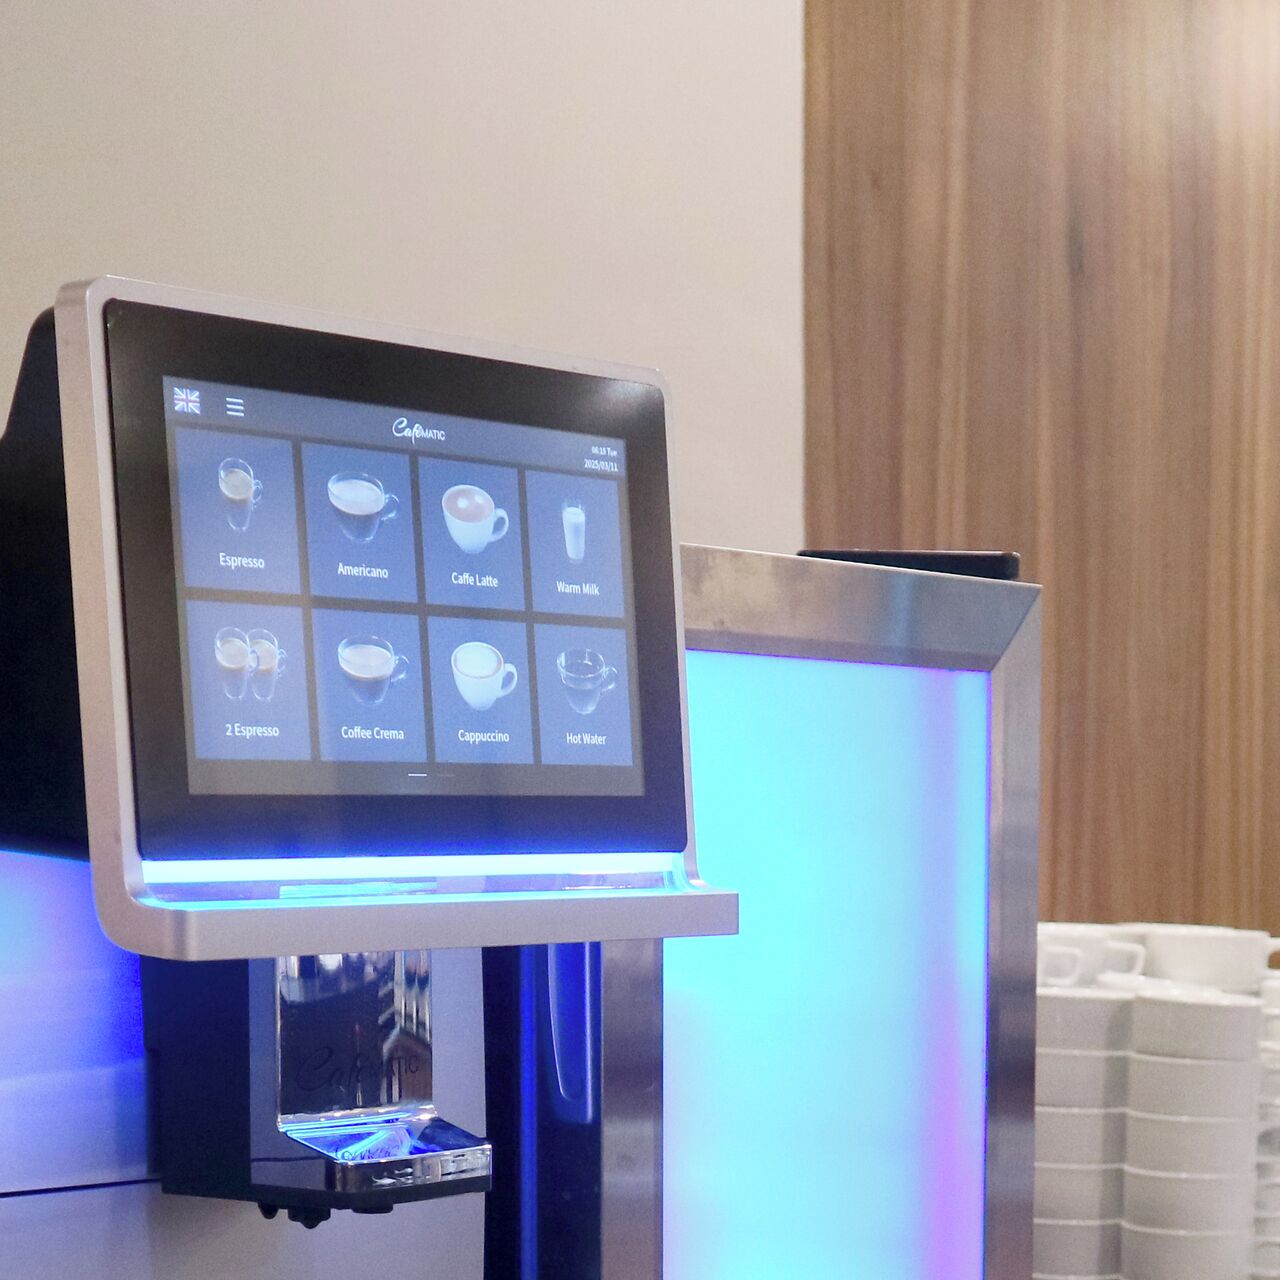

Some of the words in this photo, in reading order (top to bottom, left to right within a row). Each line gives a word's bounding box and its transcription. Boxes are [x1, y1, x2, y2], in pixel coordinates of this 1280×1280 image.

[584, 458, 619, 472] 2025/03/11
[219, 552, 265, 570] Espresso
[337, 562, 389, 579] Americano
[451, 571, 474, 585] Caffe
[475, 573, 499, 588] Latte
[556, 581, 581, 594] Warm
[582, 583, 600, 596] Milk
[225, 723, 233, 736] 2
[234, 723, 280, 739] Espresso
[341, 726, 372, 739] Coffee
[373, 727, 405, 740] Crema
[458, 729, 510, 744] Cappuccino
[566, 732, 582, 744] Hot
[582, 733, 607, 745] Water
